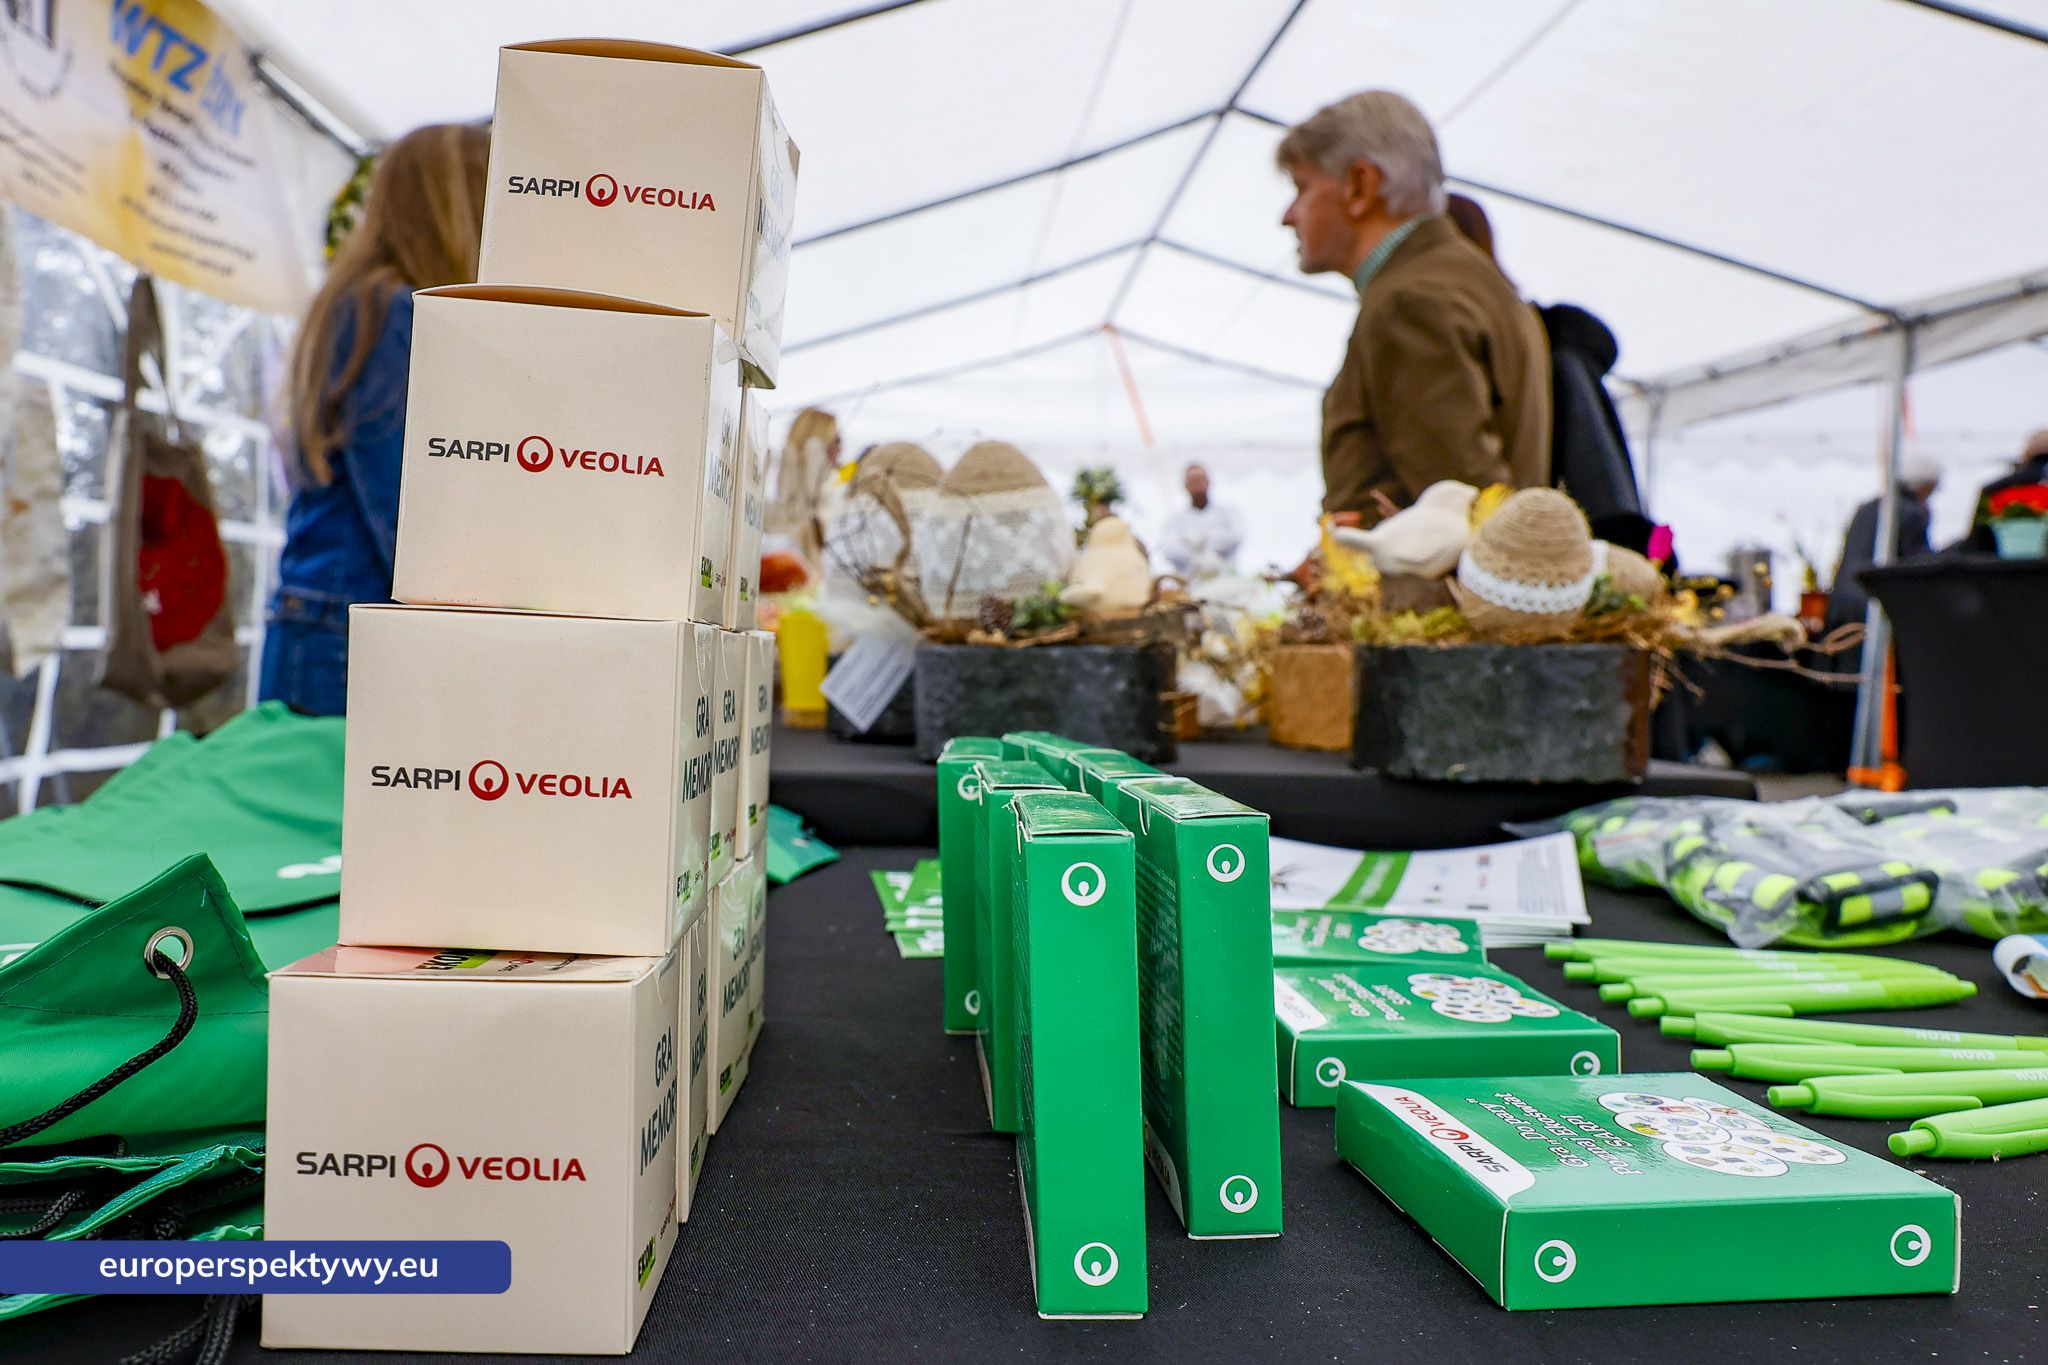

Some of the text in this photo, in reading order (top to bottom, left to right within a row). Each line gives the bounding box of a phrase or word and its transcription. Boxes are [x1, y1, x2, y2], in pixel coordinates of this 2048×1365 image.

[110, 0, 208, 93] WTZ
[508, 176, 716, 212] SARPI VEOLIA
[428, 438, 665, 477] SARPI VEOLIA
[696, 696, 709, 738] GRA
[371, 766, 632, 799] SARPI VEOLIA
[656, 1026, 672, 1087] GRA
[640, 1076, 677, 1176] MEMOR
[1394, 1096, 1510, 1173] SARPI VEOLIA
[1559, 1114, 1634, 1147] SARPI
[296, 1152, 587, 1181] SARPI VEOLIA
[1548, 1146, 1590, 1167] Gra
[1566, 1137, 1645, 1175] Poznaj
